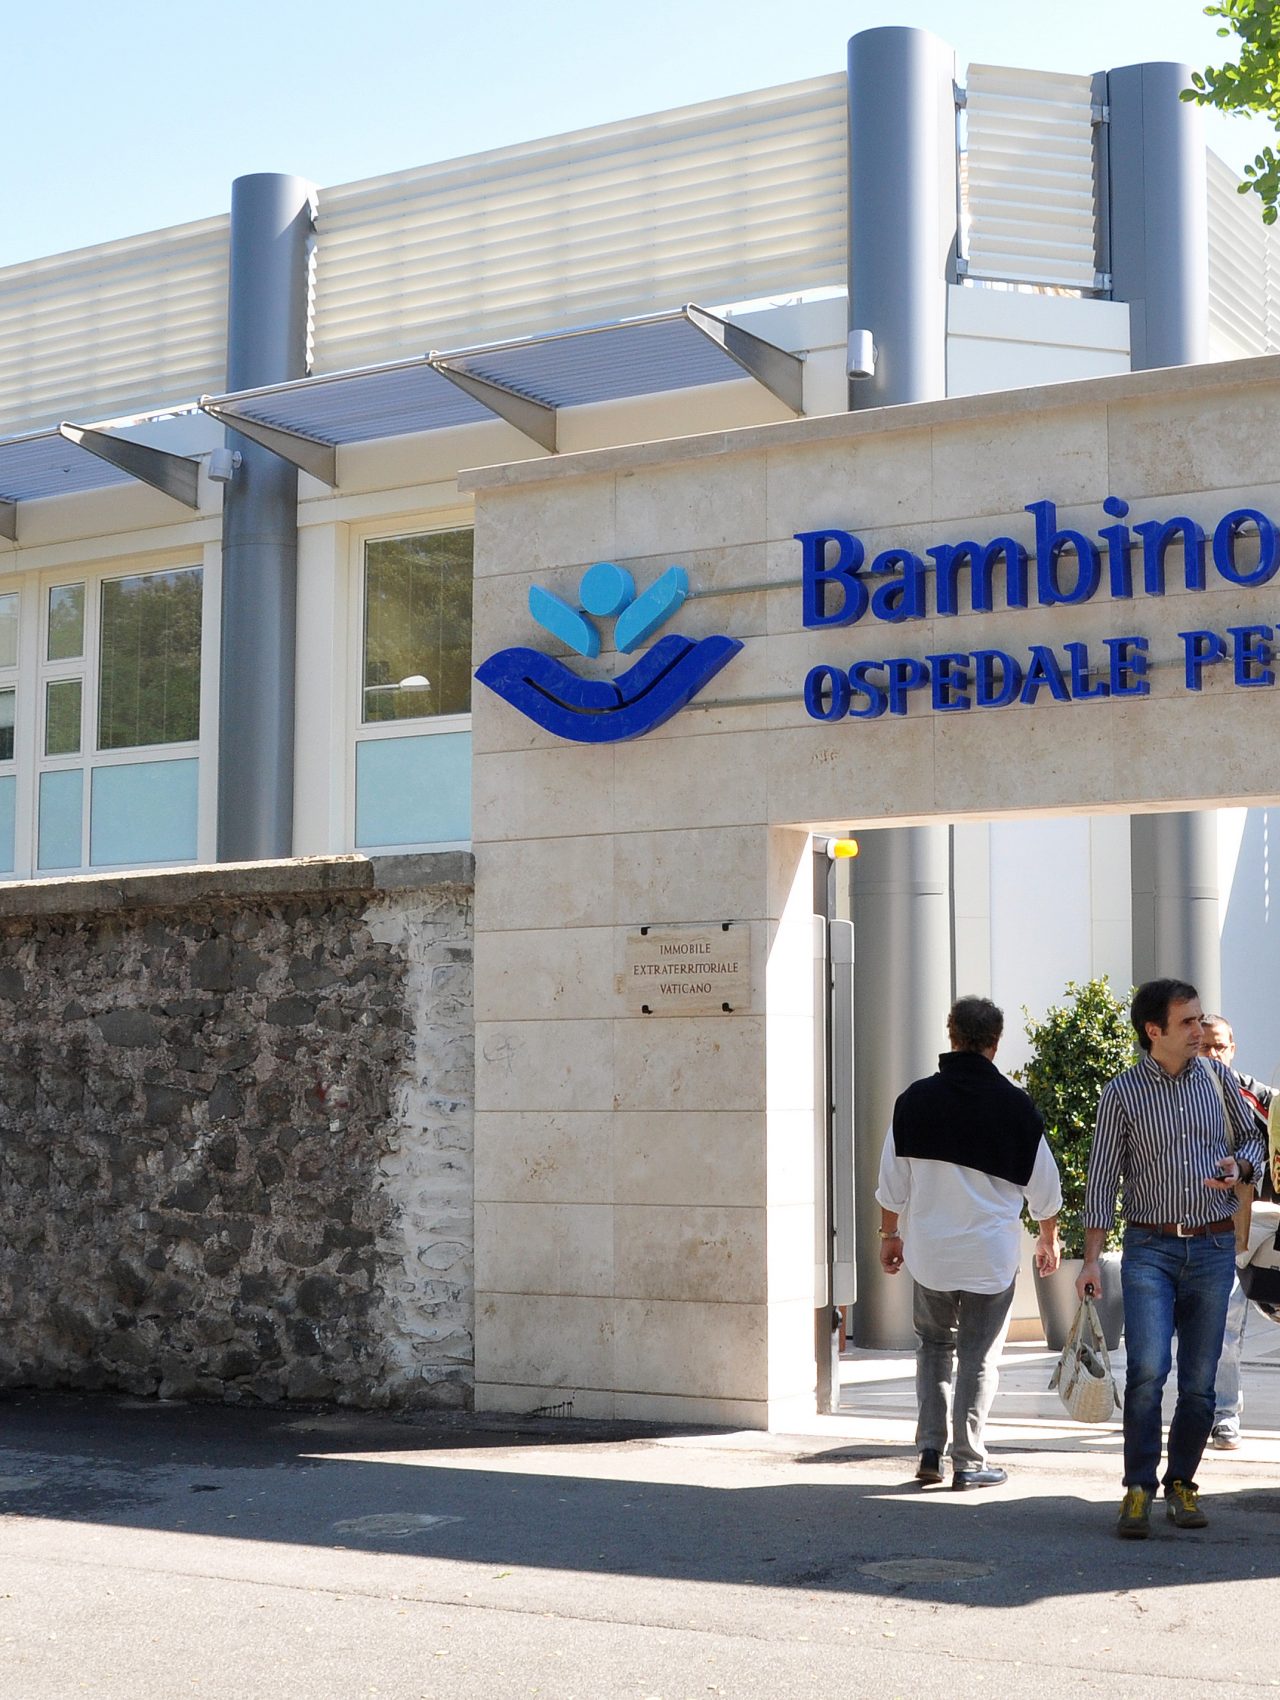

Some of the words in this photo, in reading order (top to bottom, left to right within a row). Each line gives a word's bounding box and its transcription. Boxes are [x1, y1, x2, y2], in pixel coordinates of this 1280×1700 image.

[804, 636, 1150, 722] OSPEDALE
[659, 943, 712, 956] IMMOBILE
[633, 962, 739, 976] EXTRATERRITORIALE
[659, 982, 712, 995] VATICANO
